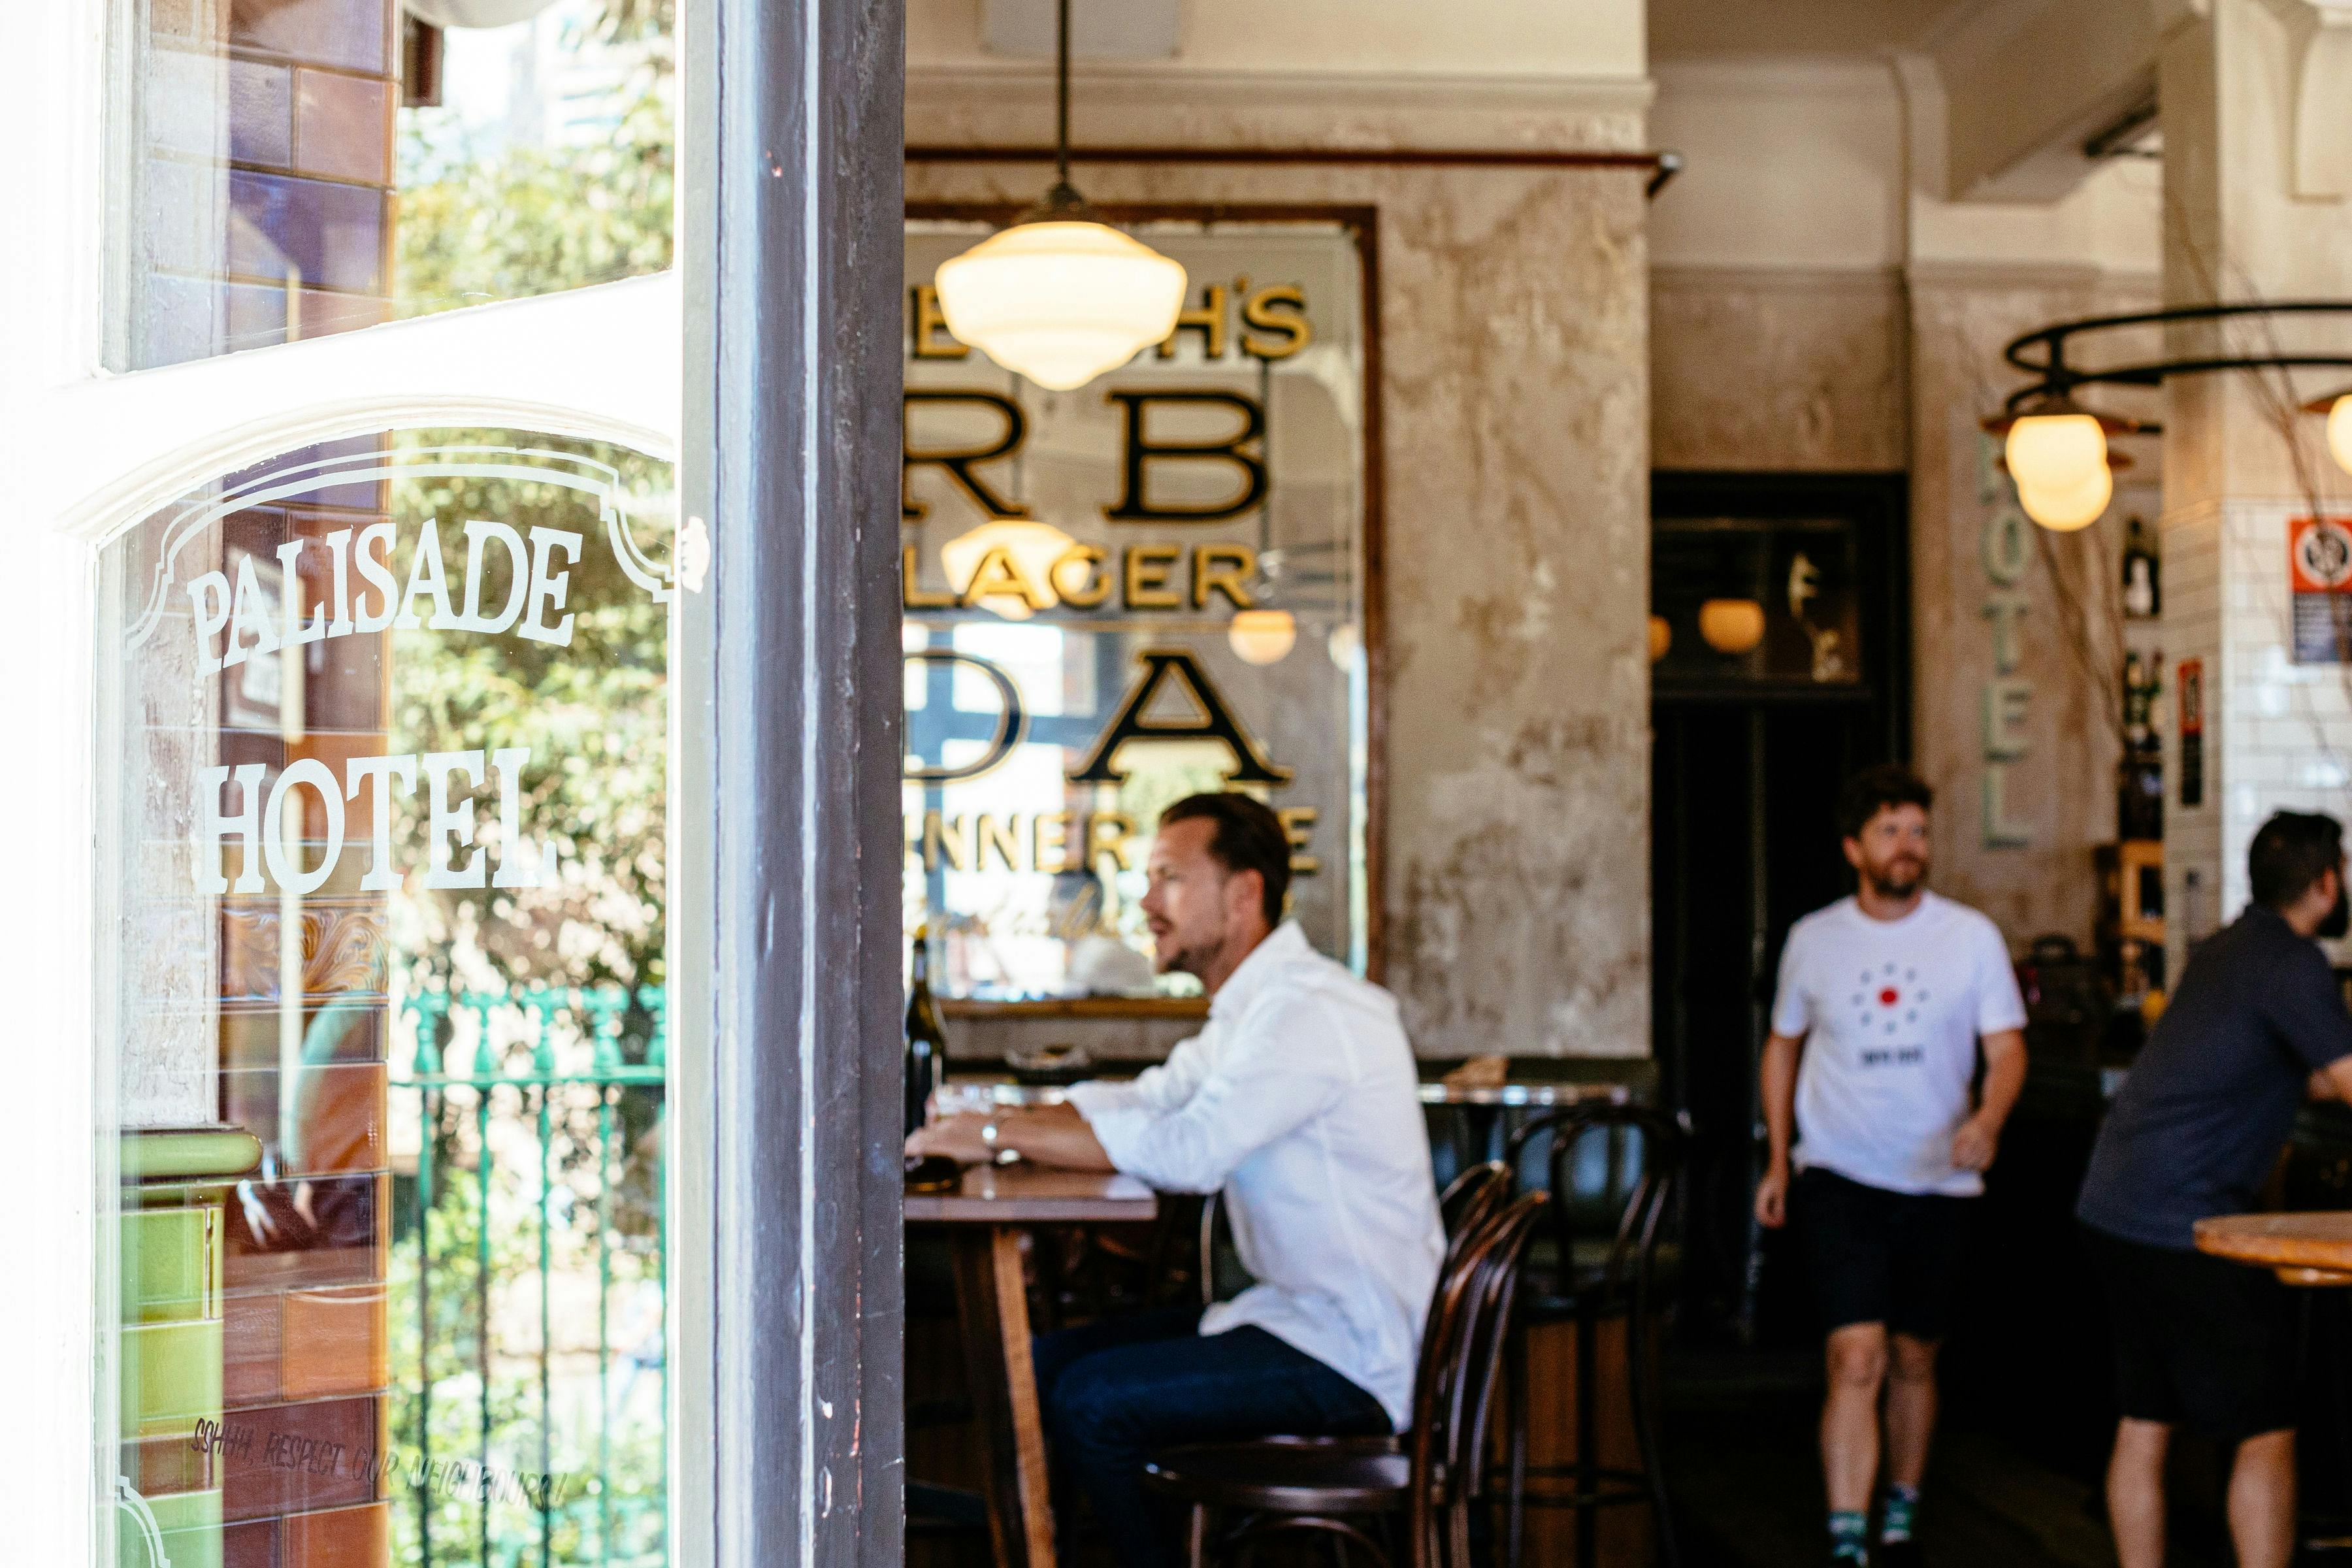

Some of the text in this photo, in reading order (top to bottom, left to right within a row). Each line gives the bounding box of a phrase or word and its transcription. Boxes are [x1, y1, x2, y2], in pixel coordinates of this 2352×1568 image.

[186, 517, 583, 682] PALISADE
[903, 544, 1258, 611] LAGER
[195, 747, 557, 895] HOTEL
[263, 1431, 346, 1475] RESPECT
[351, 1446, 399, 1487] OUR
